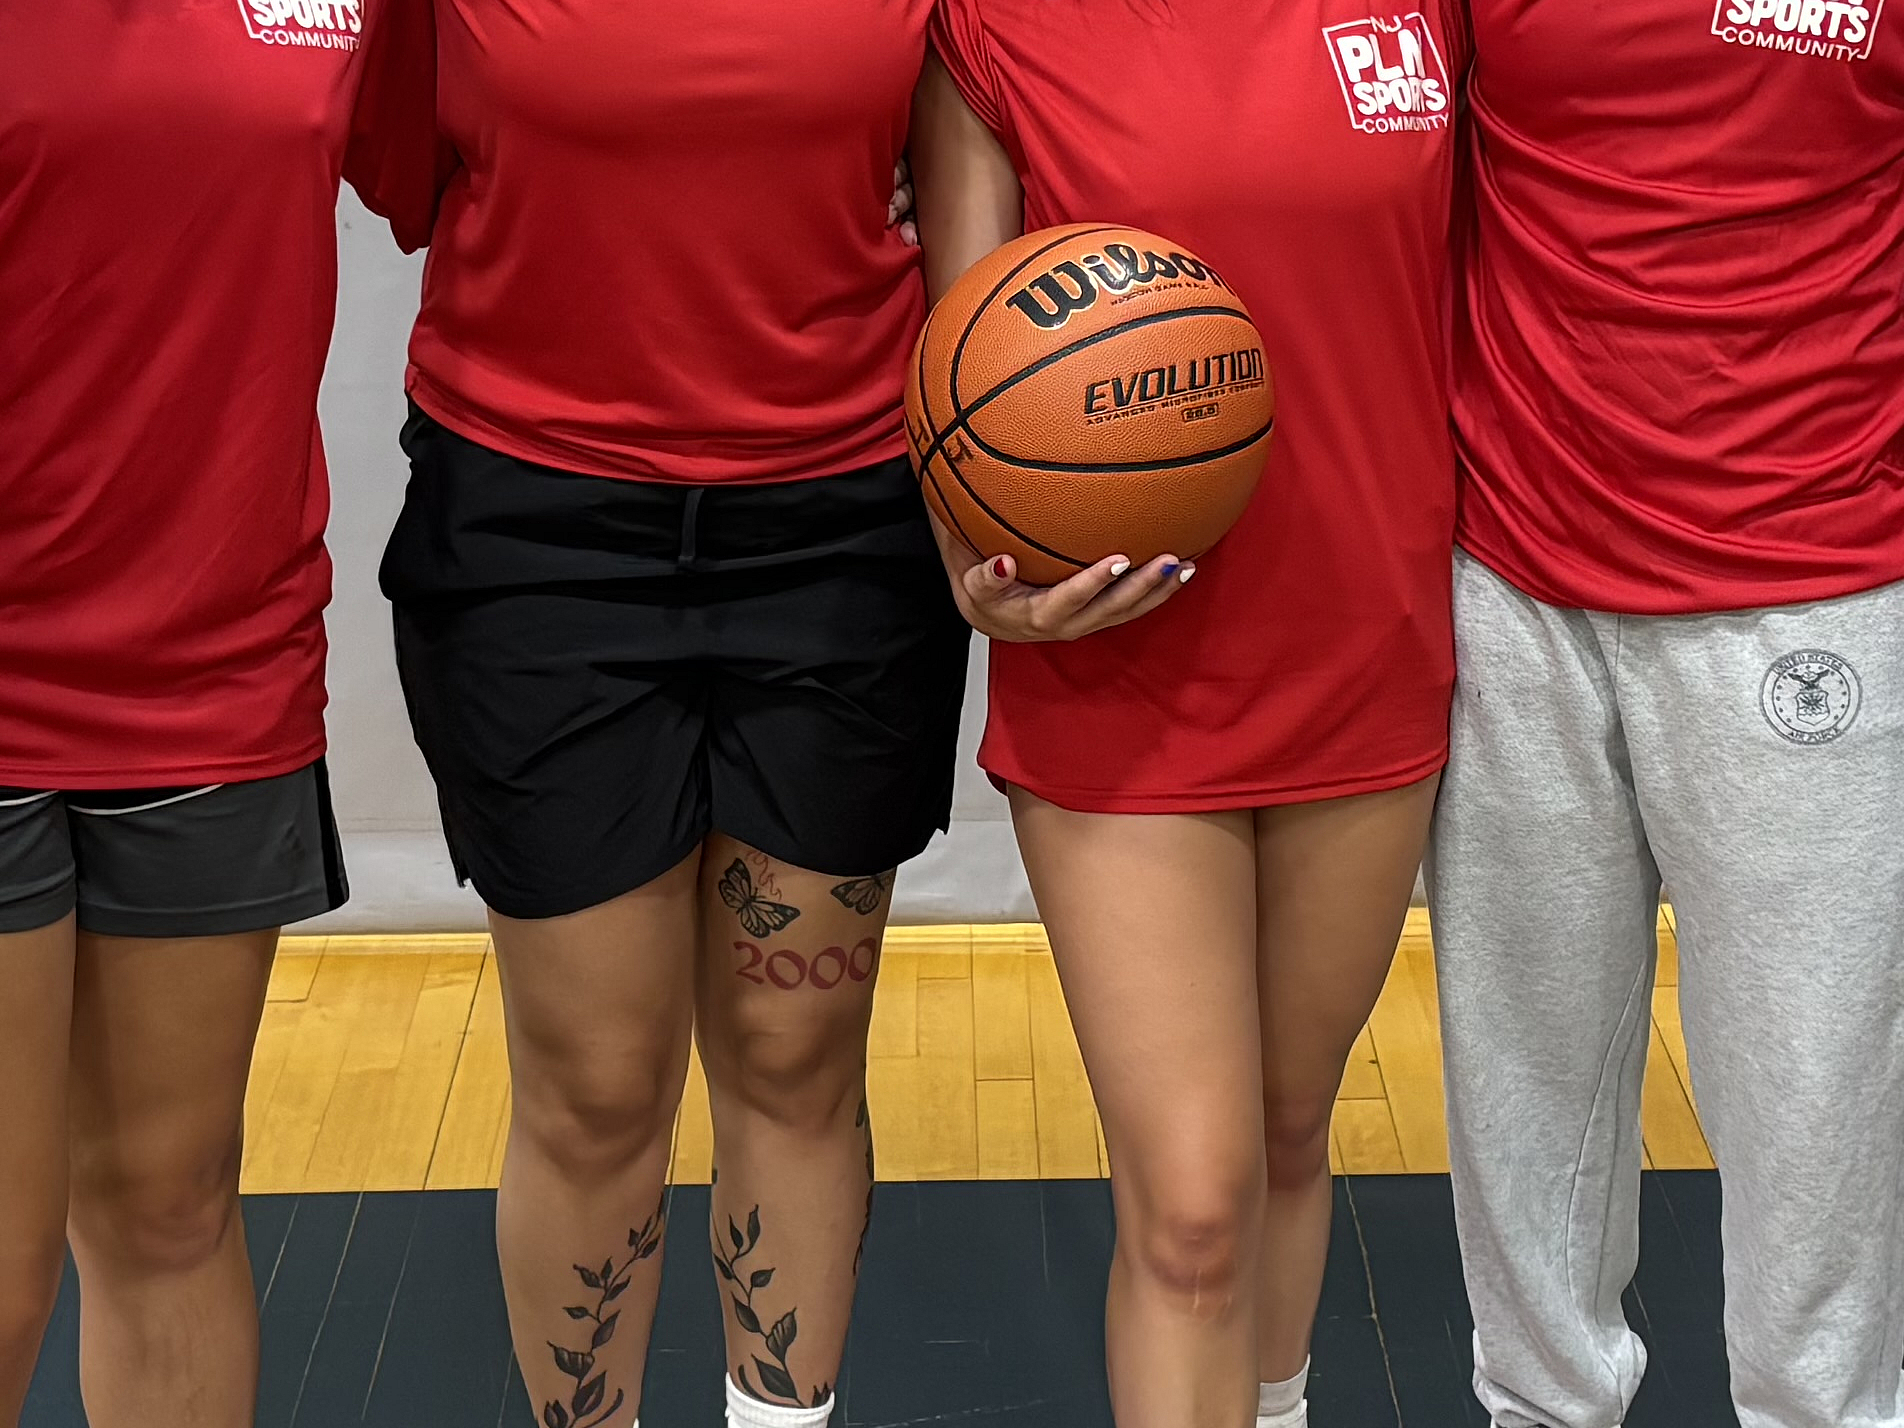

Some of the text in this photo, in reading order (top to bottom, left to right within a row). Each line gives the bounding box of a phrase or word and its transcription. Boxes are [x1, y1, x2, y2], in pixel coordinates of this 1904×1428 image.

[1369, 15, 1402, 34] NJ
[1722, 26, 1860, 62] COMMUNITY
[1005, 243, 1237, 330] Wilson
[1083, 347, 1264, 415] EVOLUTION
[733, 937, 877, 991] 2000
